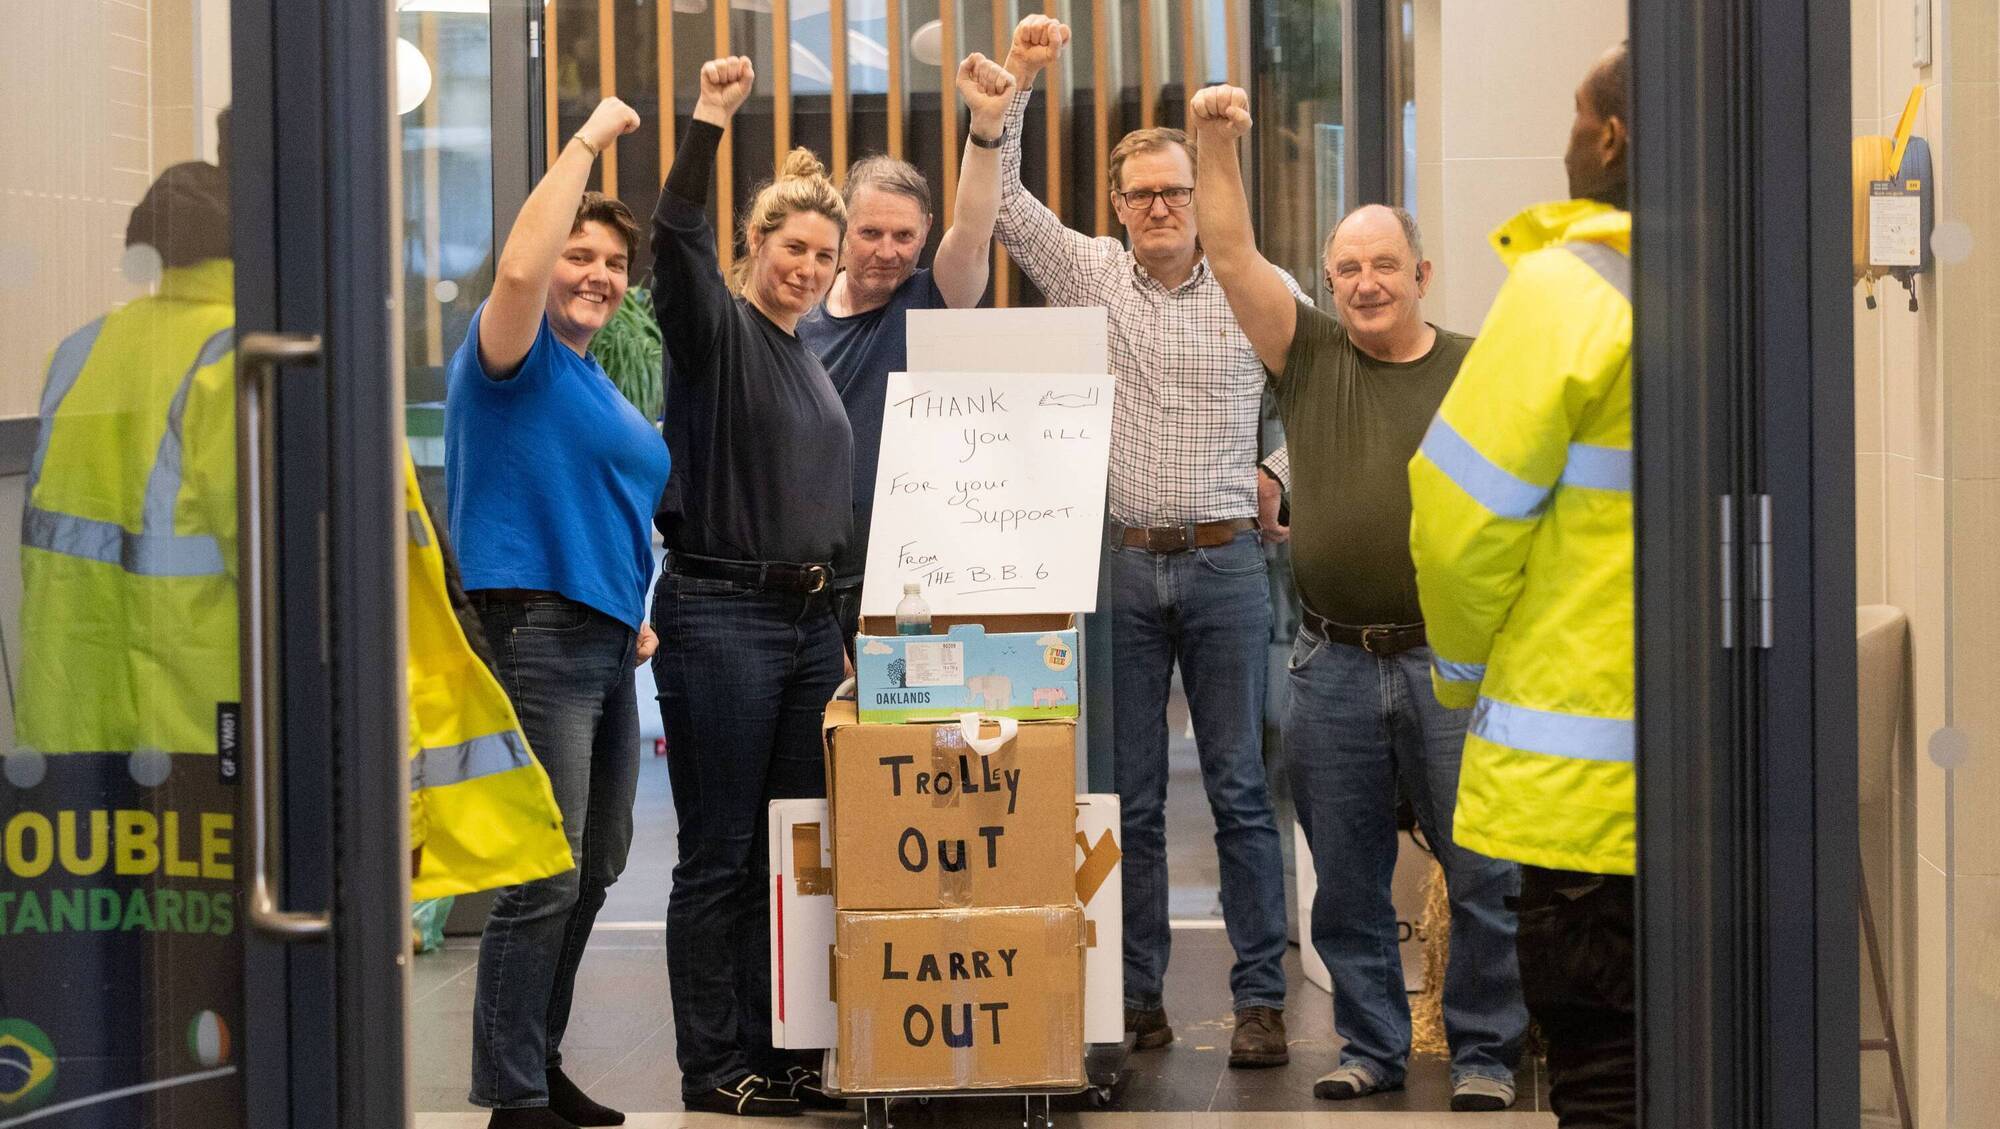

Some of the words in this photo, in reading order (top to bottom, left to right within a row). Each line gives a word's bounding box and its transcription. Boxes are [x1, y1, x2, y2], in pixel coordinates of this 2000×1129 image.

[893, 387, 1008, 418] THANK
[1043, 429, 1091, 440] ALL
[922, 566, 956, 587] THE
[1035, 562, 1049, 580] 6
[876, 691, 931, 705] OAKLANDS
[0, 810, 234, 880] OUBLE
[882, 942, 1018, 982] LARRY
[903, 1002, 1009, 1049] OUT
